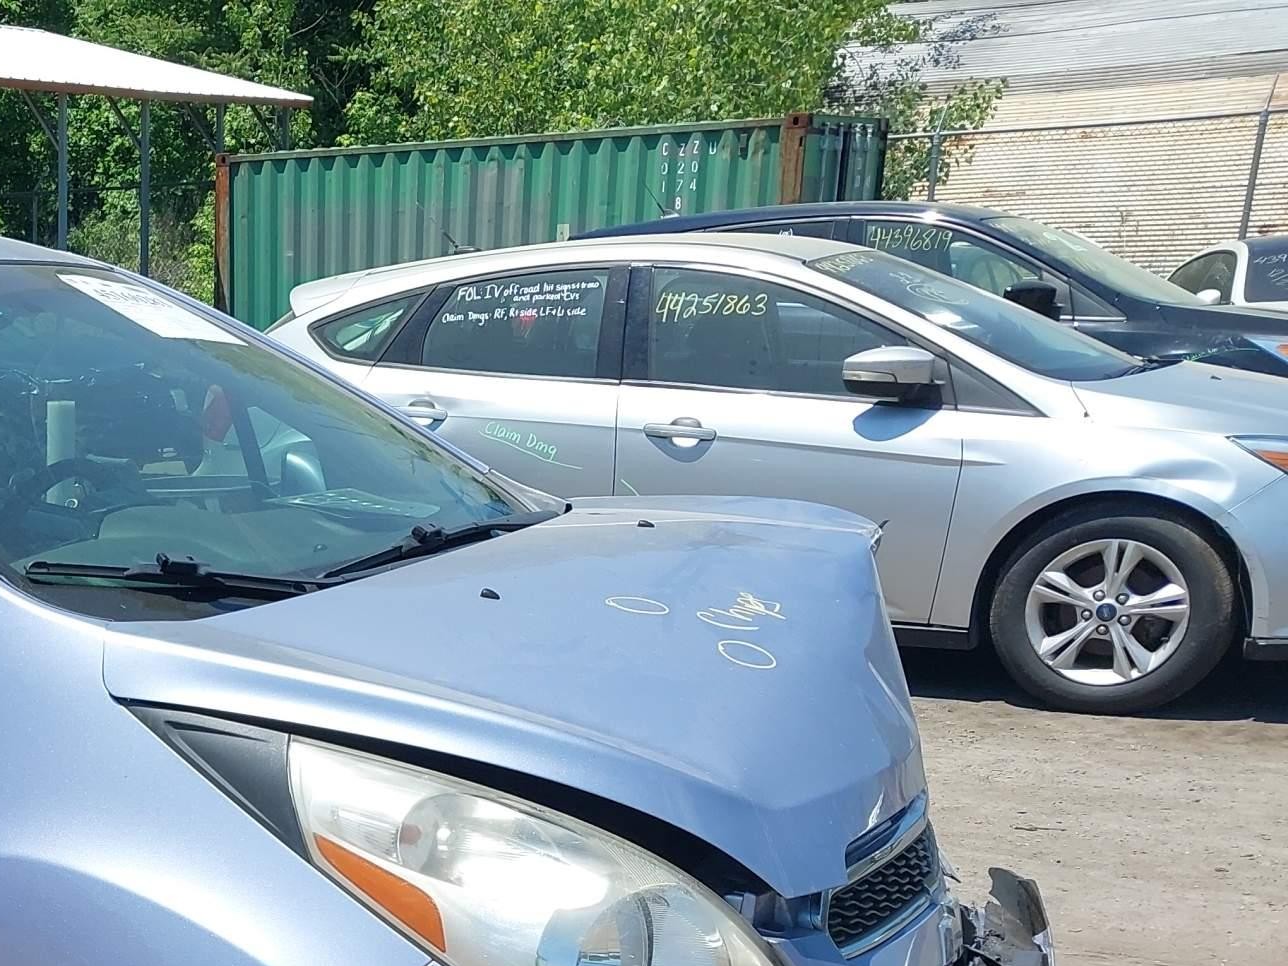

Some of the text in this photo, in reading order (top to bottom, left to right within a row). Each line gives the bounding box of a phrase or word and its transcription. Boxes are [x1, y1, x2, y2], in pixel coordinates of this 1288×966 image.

[674, 196, 682, 210] 8
[870, 223, 954, 252] 44396819
[513, 293, 530, 302] and
[655, 291, 768, 323] 44251863
[442, 312, 464, 323] Claim
[485, 421, 557, 462] Claim Dmg
